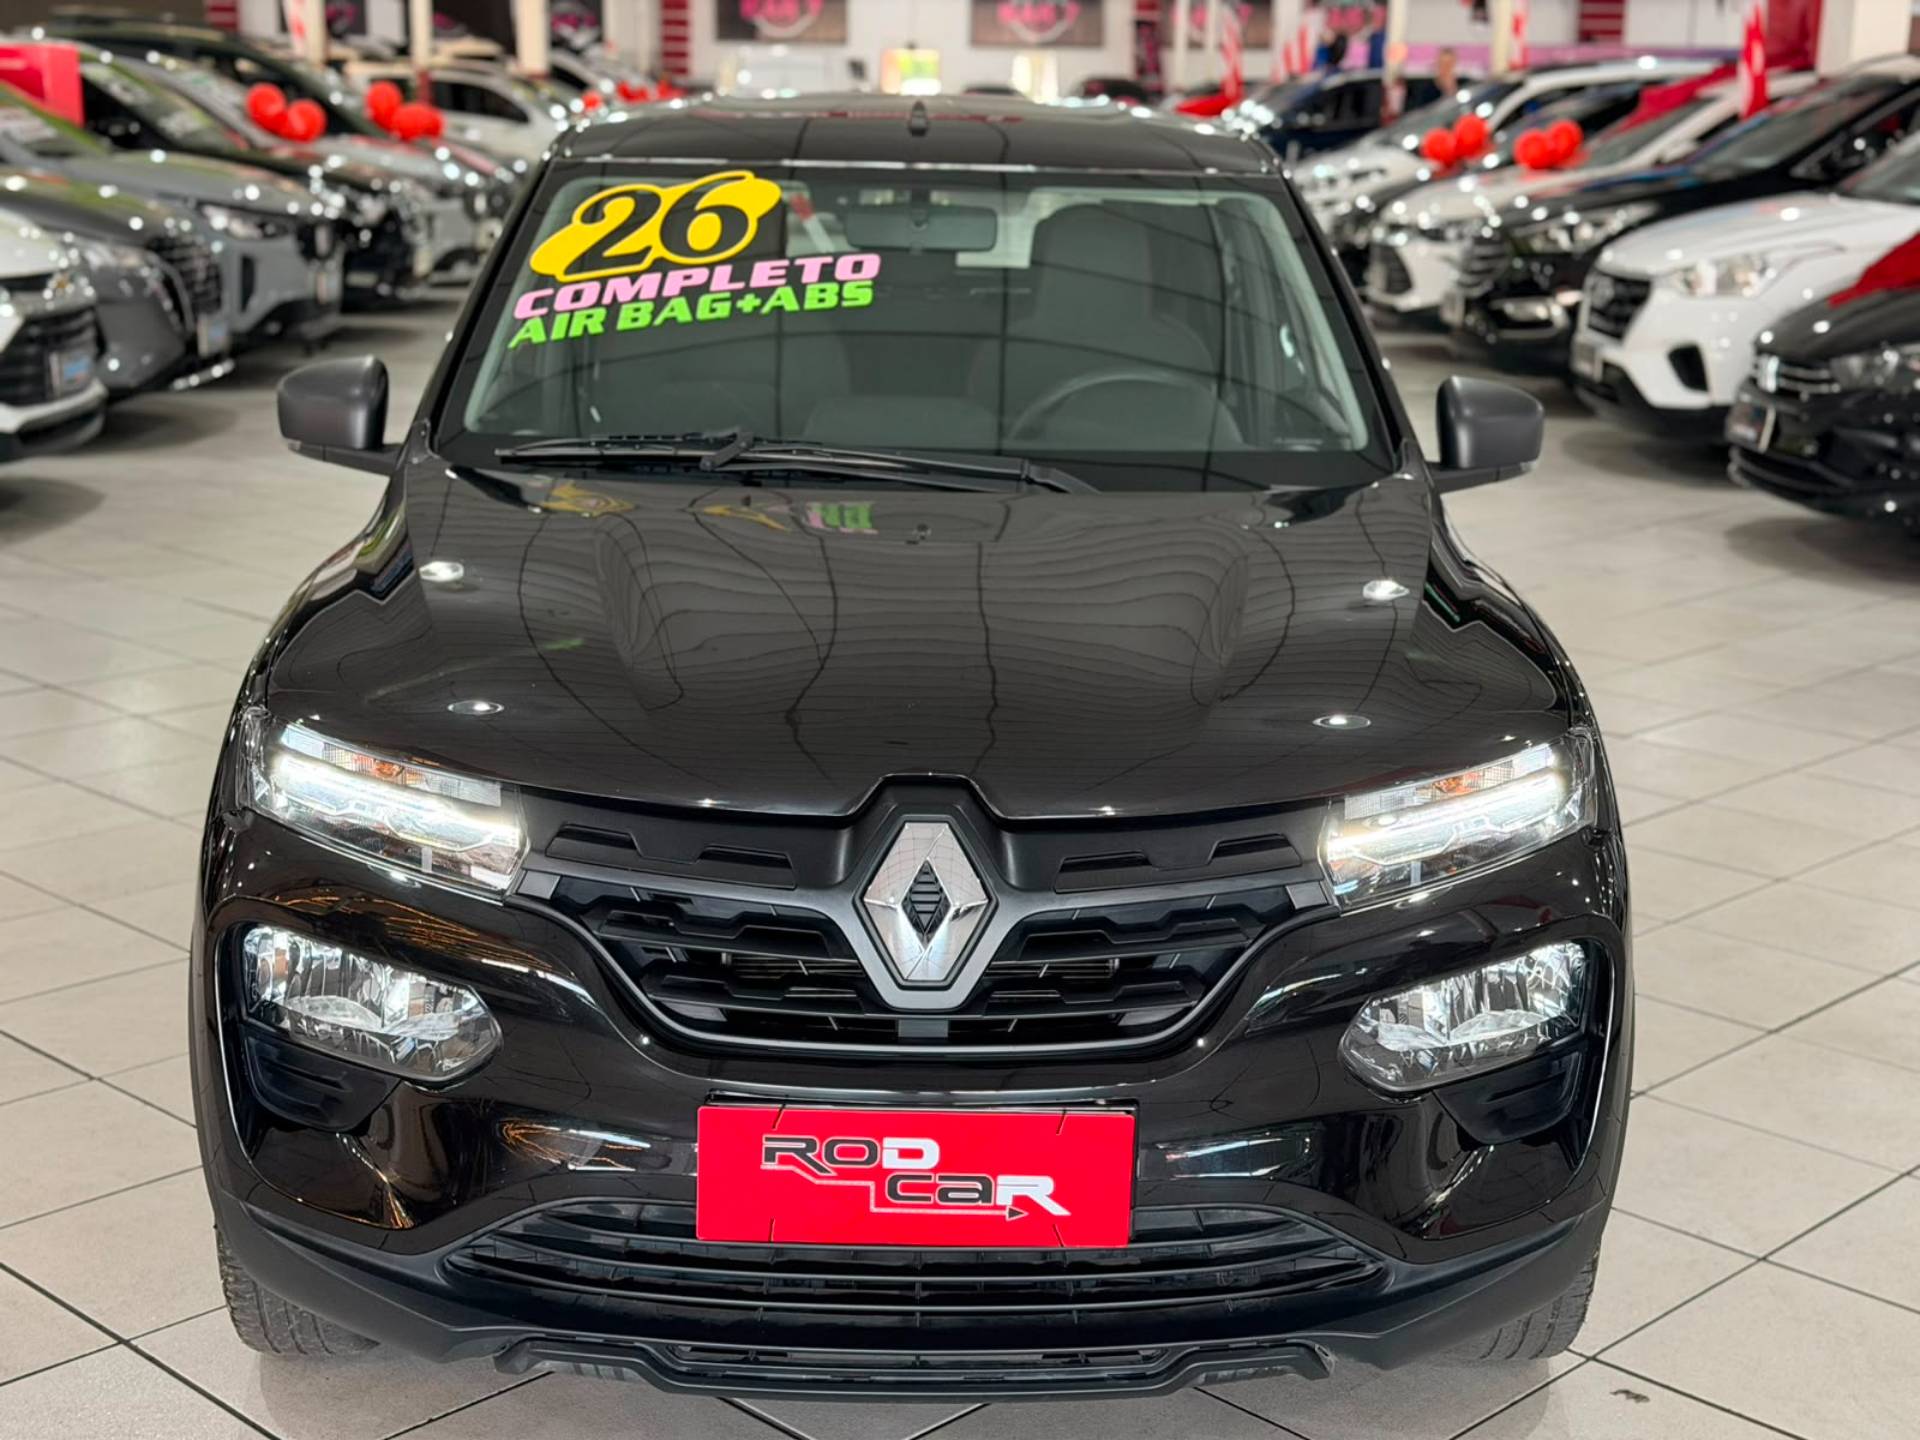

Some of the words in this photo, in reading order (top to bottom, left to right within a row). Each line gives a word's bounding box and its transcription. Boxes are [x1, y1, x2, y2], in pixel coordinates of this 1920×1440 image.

[561, 174, 754, 275] 26
[507, 307, 605, 349] AIR
[616, 280, 875, 332] BAG+ABS
[514, 253, 882, 320] COMPLETO
